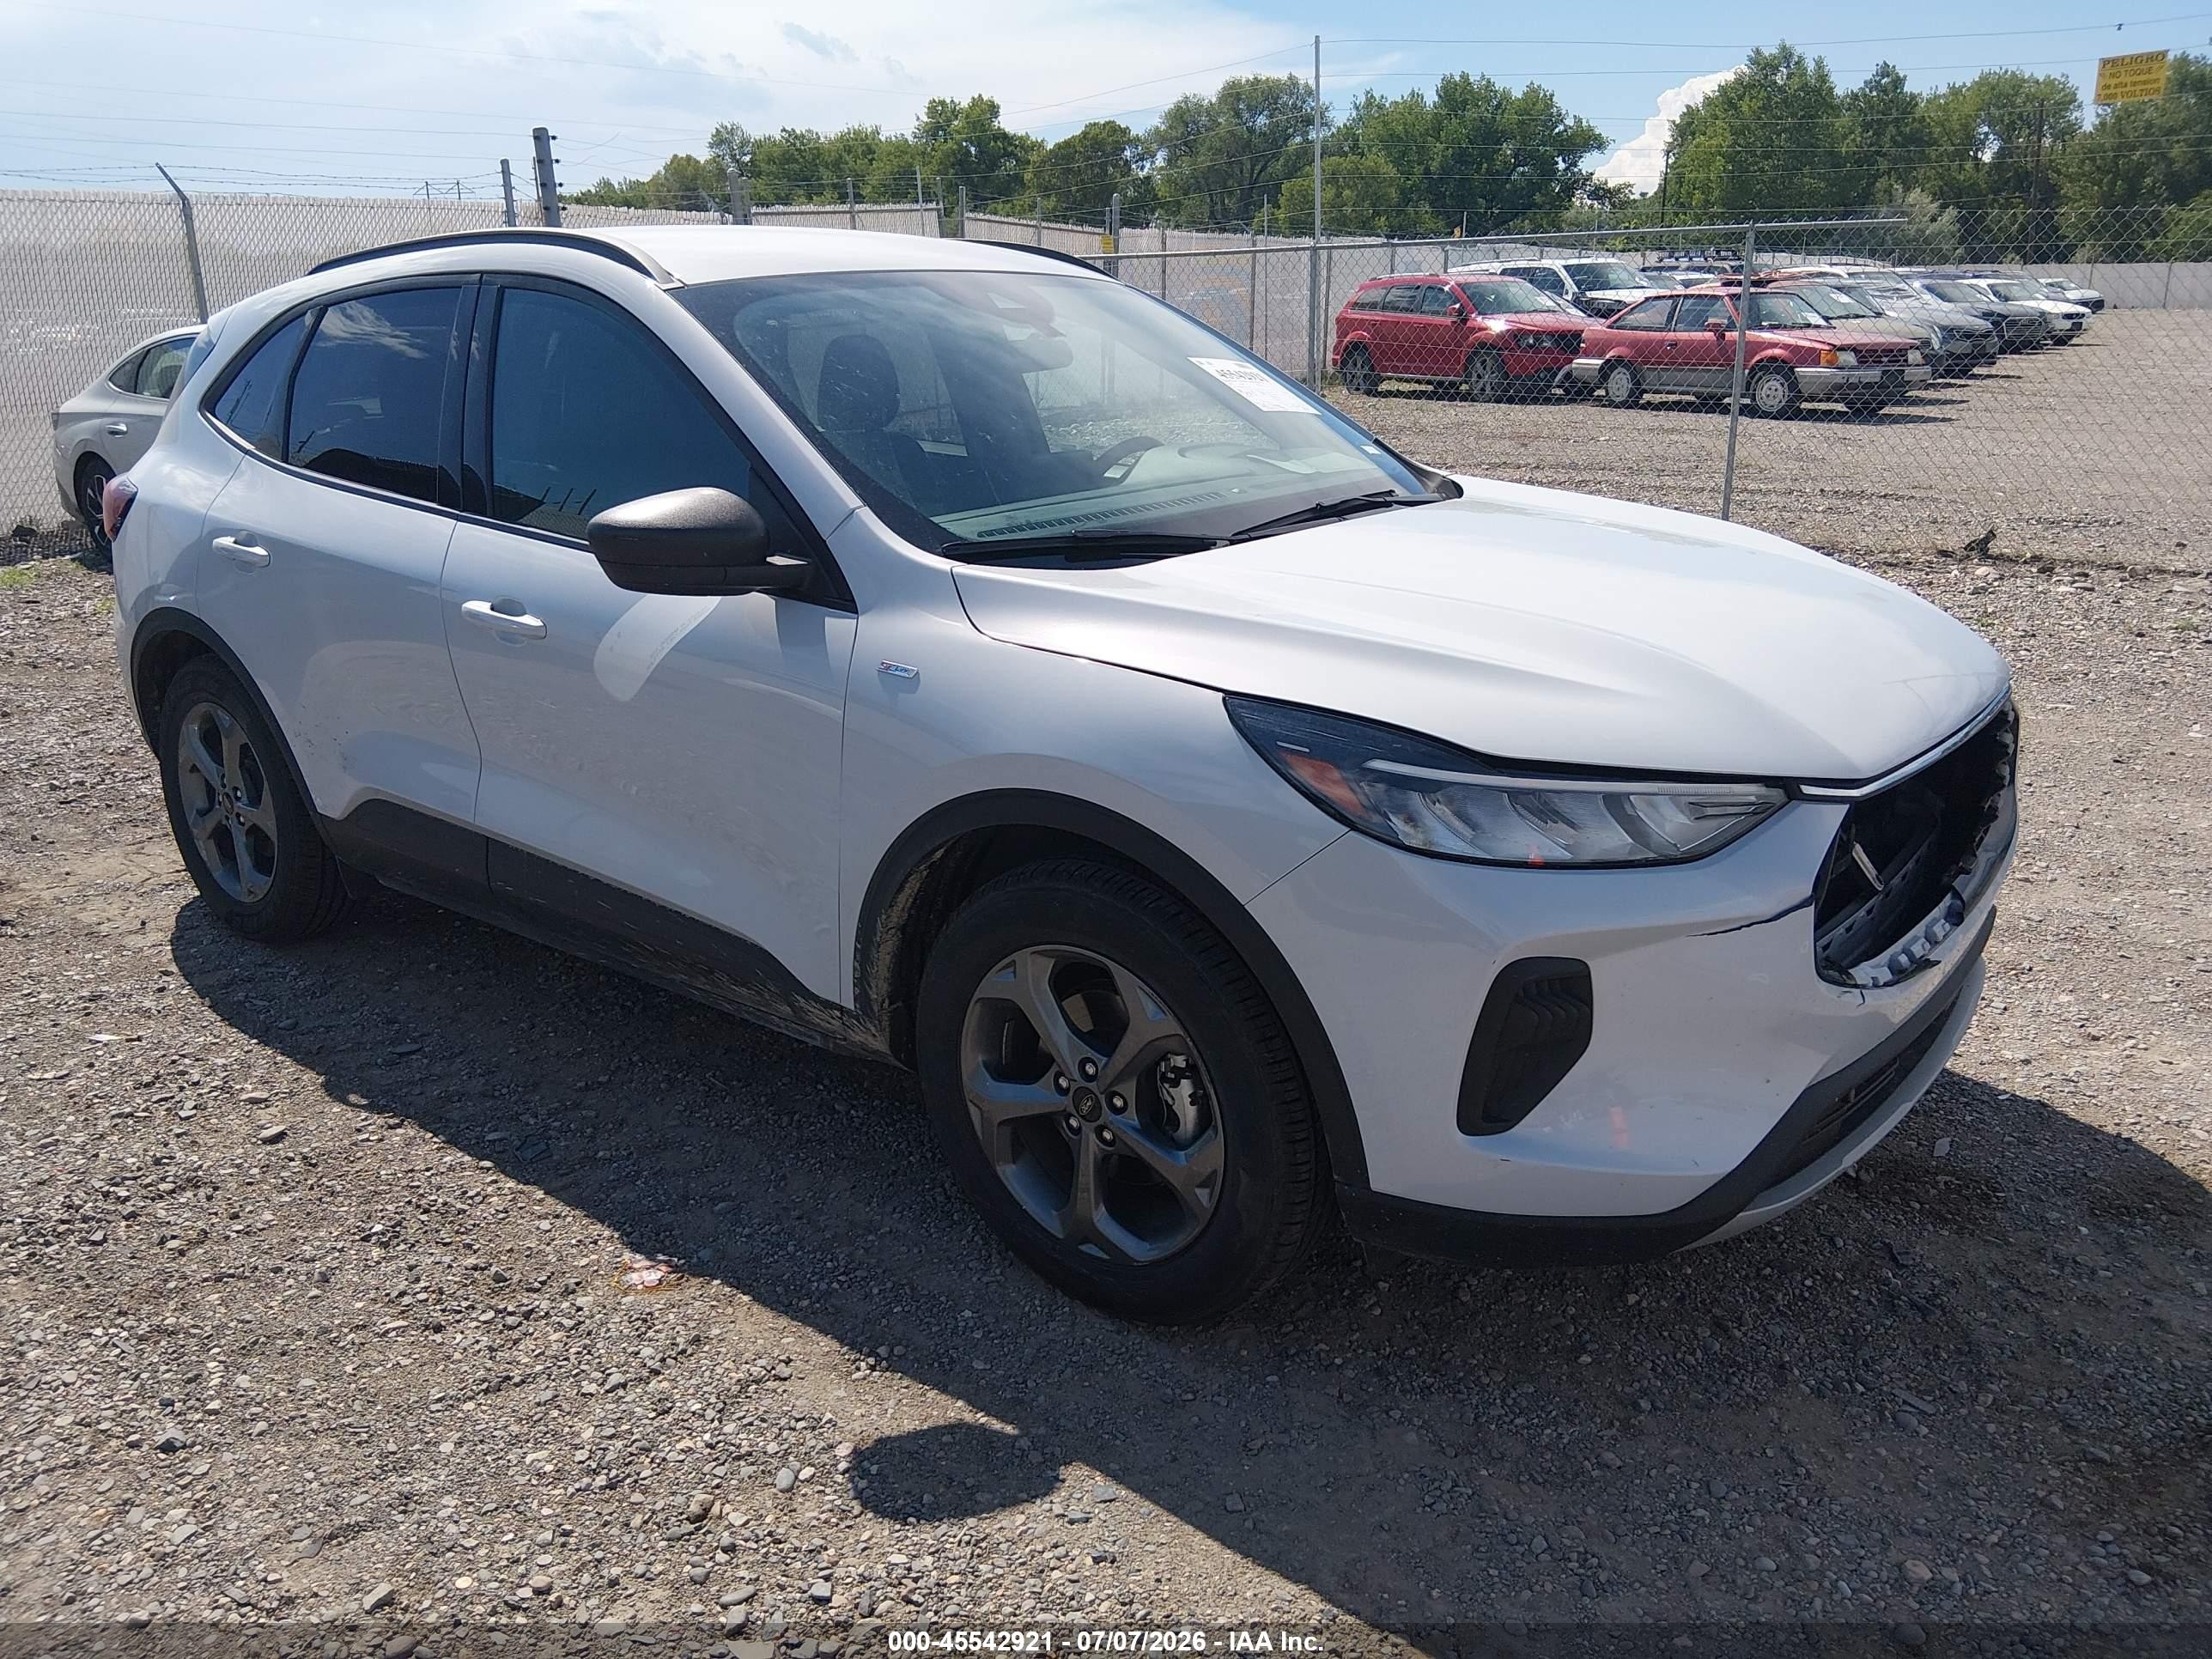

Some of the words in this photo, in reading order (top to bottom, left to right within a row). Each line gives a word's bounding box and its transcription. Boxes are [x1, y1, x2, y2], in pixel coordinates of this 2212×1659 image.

[2101, 52, 2165, 69] PELIGRO
[2109, 70, 2122, 79] NO
[2124, 67, 2154, 77] TOQUE
